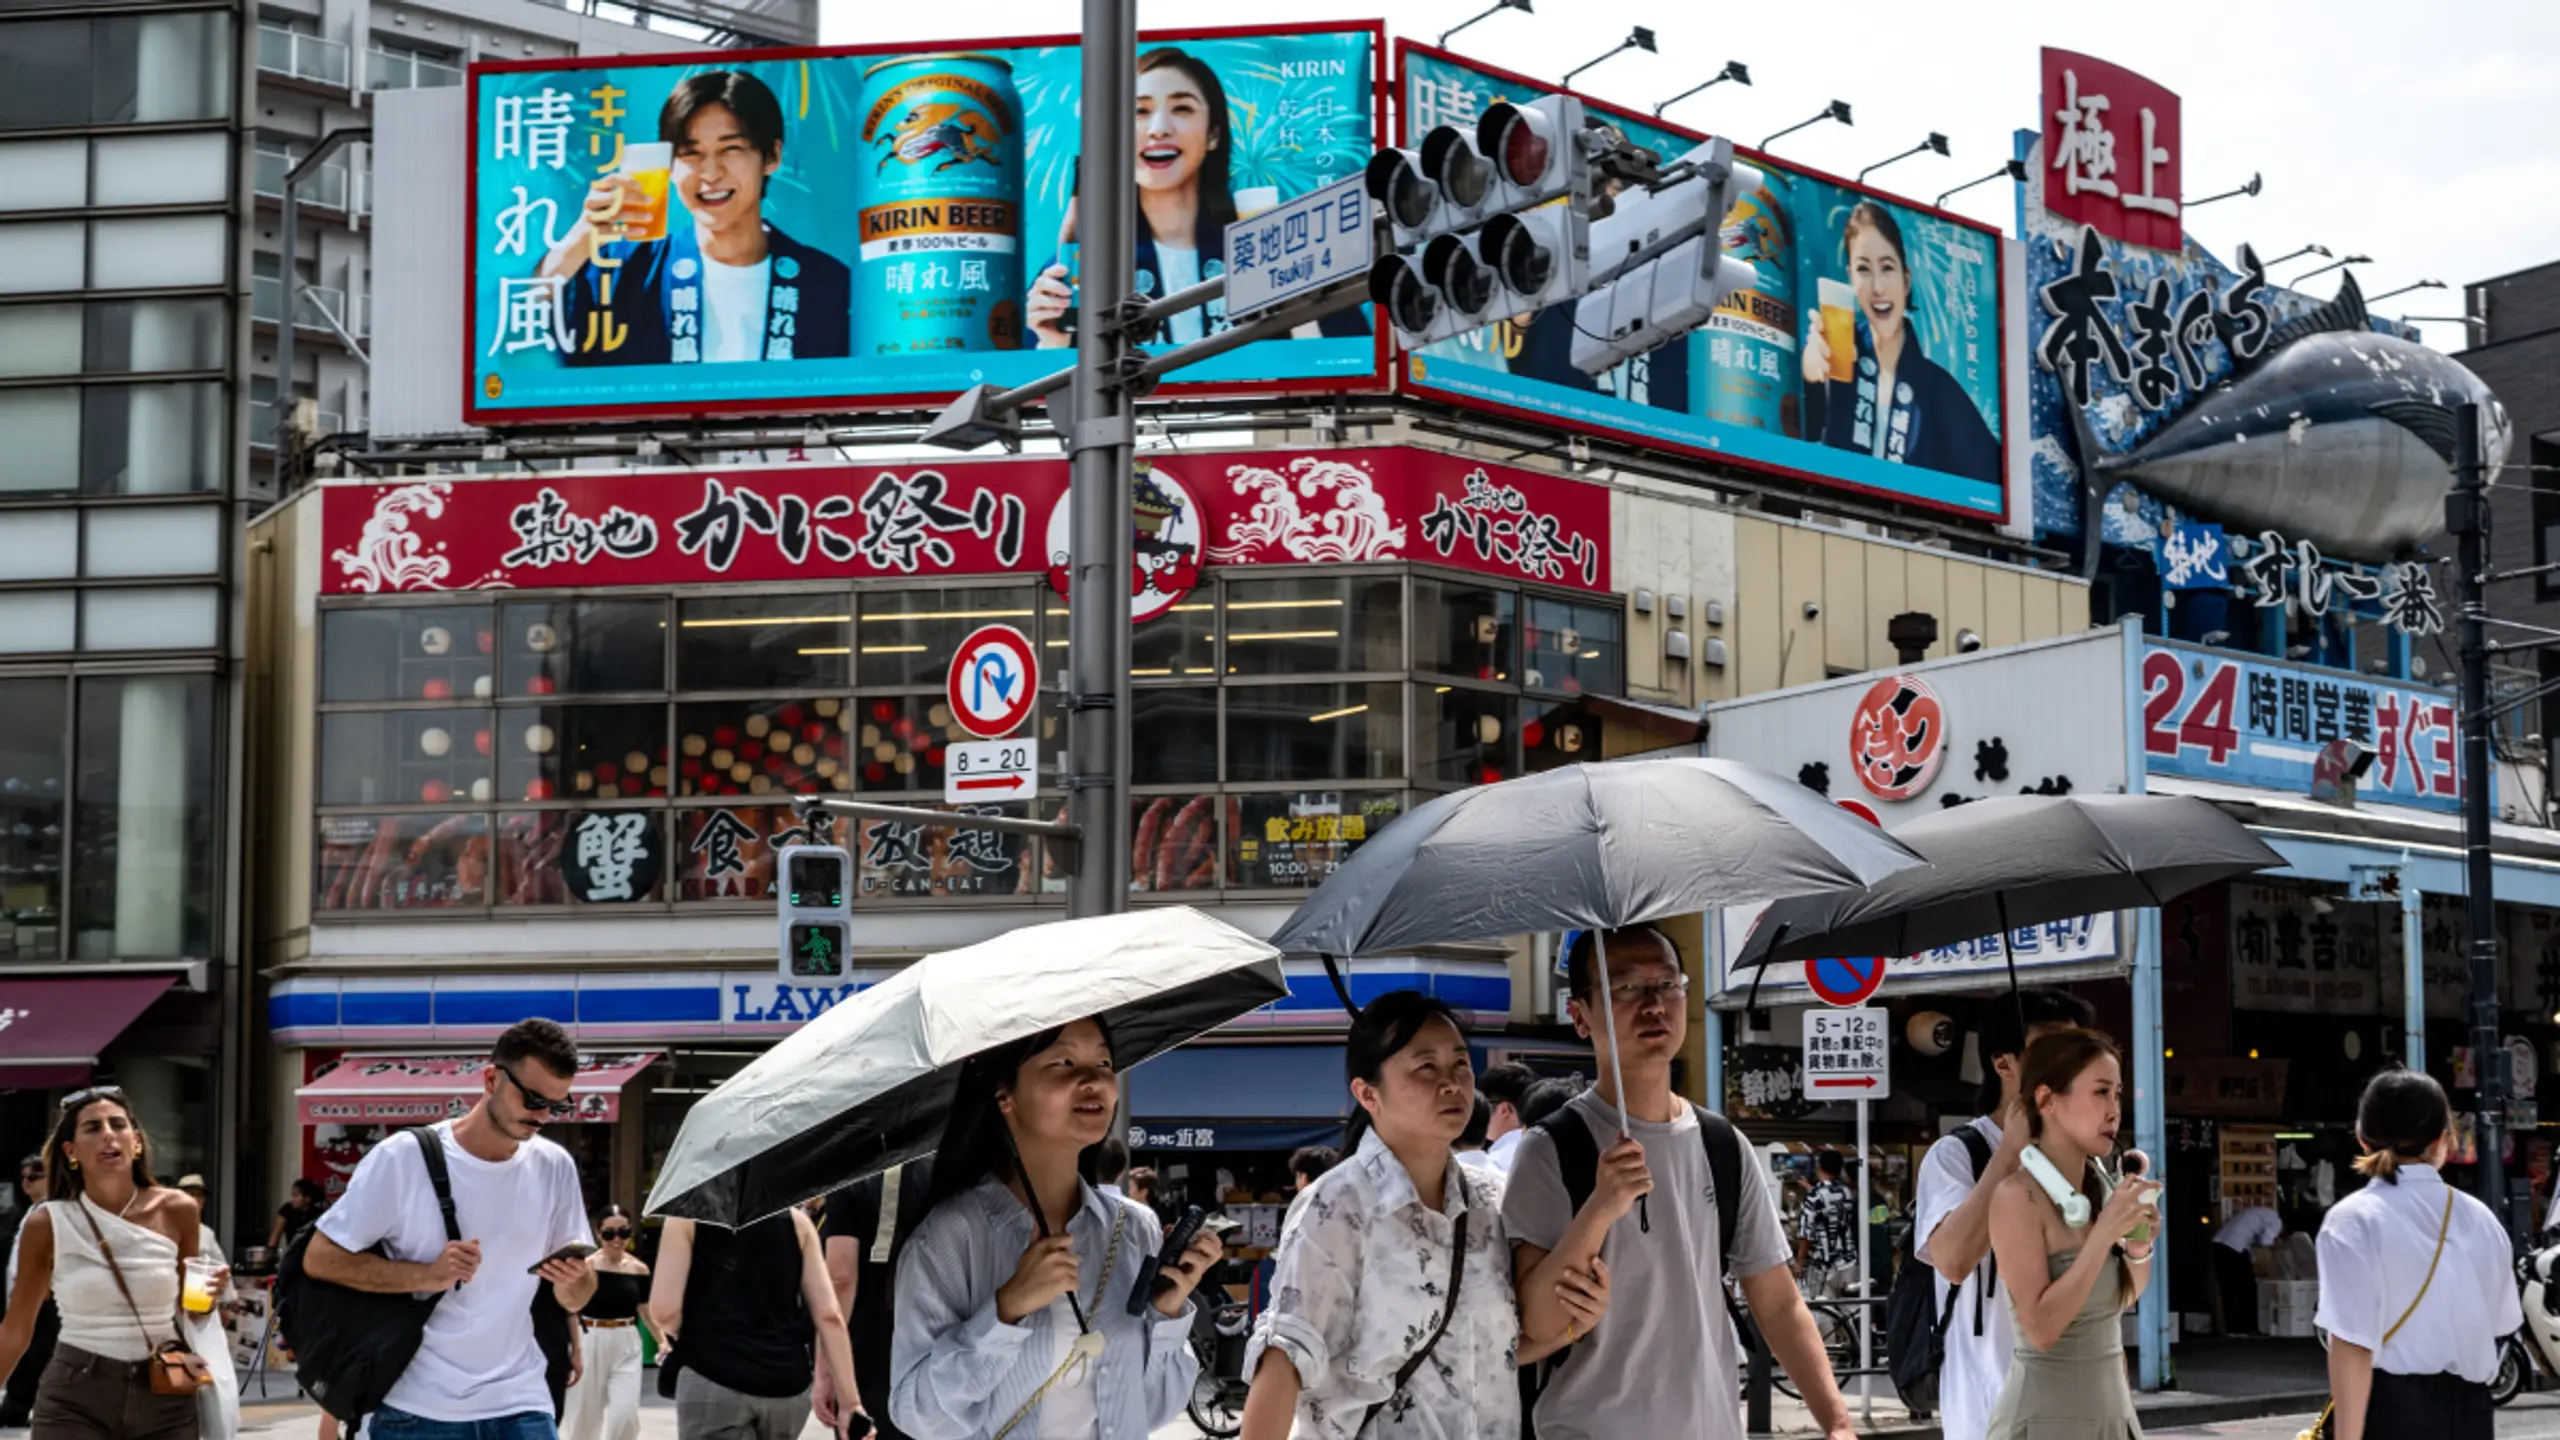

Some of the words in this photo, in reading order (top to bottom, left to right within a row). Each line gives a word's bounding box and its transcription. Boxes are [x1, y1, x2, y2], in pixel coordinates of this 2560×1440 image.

[1280, 59, 1346, 79] KIRIN
[2052, 68, 2180, 219] 極上
[488, 87, 577, 358] 晴れ風
[582, 84, 629, 354] キリンビール
[869, 205, 940, 235] KIRIN
[948, 203, 1006, 227] BEER
[1232, 188, 1361, 275] 築地四丁目
[885, 259, 991, 294] 晴れ風
[1268, 254, 1315, 290] Tsukiji
[1321, 247, 1332, 268] 4
[2039, 223, 2273, 409] 本まぐろ
[1710, 337, 1781, 382] 晴れ風
[1461, 467, 1527, 513] 築地
[501, 488, 658, 570] 築地
[677, 470, 1026, 573] かに祭り
[1420, 492, 1598, 585] かに祭り
[2163, 529, 2227, 586] 築地
[2243, 530, 2445, 636] すし一番
[576, 811, 650, 902] 蟹
[1265, 814, 1367, 842] 飲み放題
[1808, 1053, 1885, 1070] 貨物車を除く
[309, 1103, 359, 1117] CRABS
[366, 1102, 443, 1116] PARADISE
